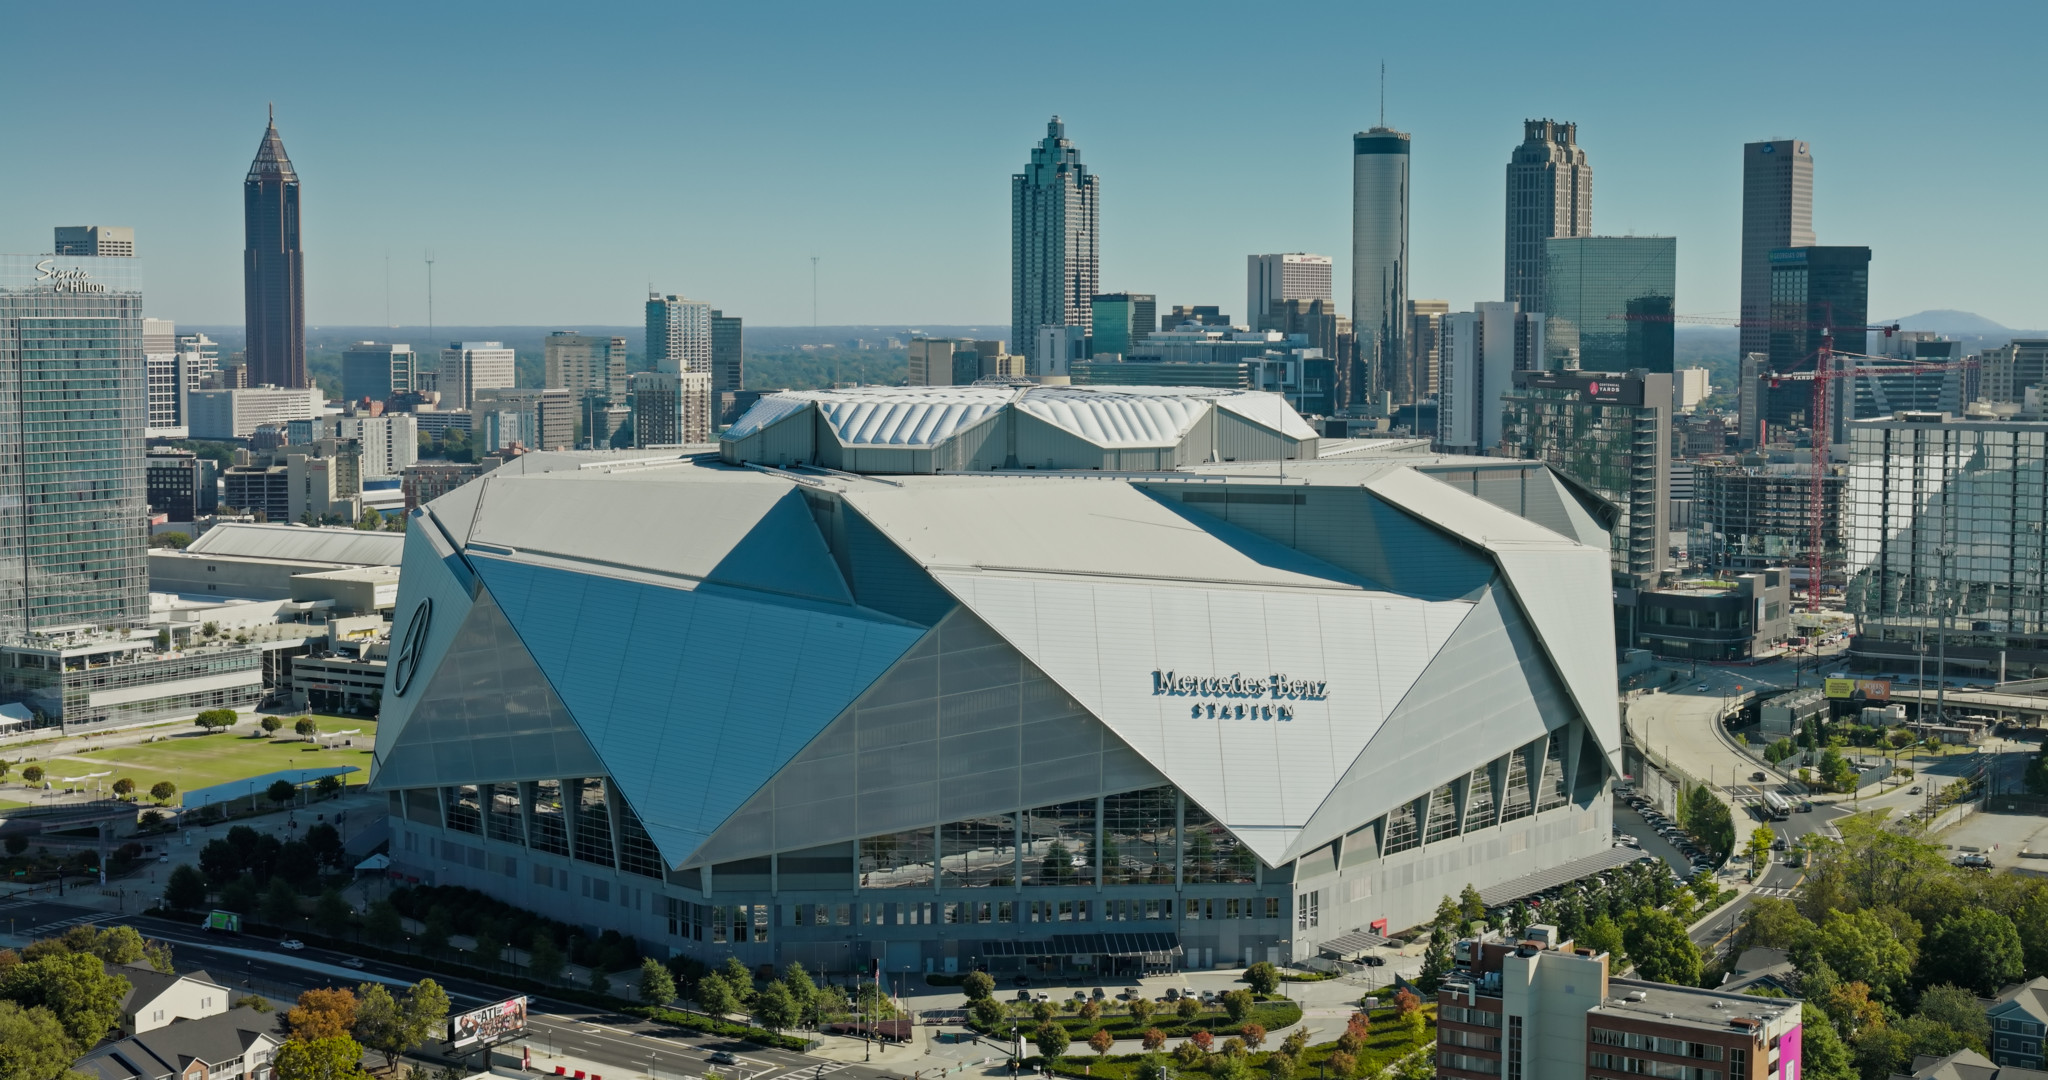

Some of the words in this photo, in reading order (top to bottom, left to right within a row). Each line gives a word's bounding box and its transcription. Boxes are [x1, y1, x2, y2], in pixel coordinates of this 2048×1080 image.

[35, 259, 93, 292] Signia
[69, 280, 106, 293] Hilton
[1152, 668, 1330, 700] Mercedes-Benz
[1863, 682, 1885, 690] JOHN
[1192, 702, 1295, 721] STADIUM
